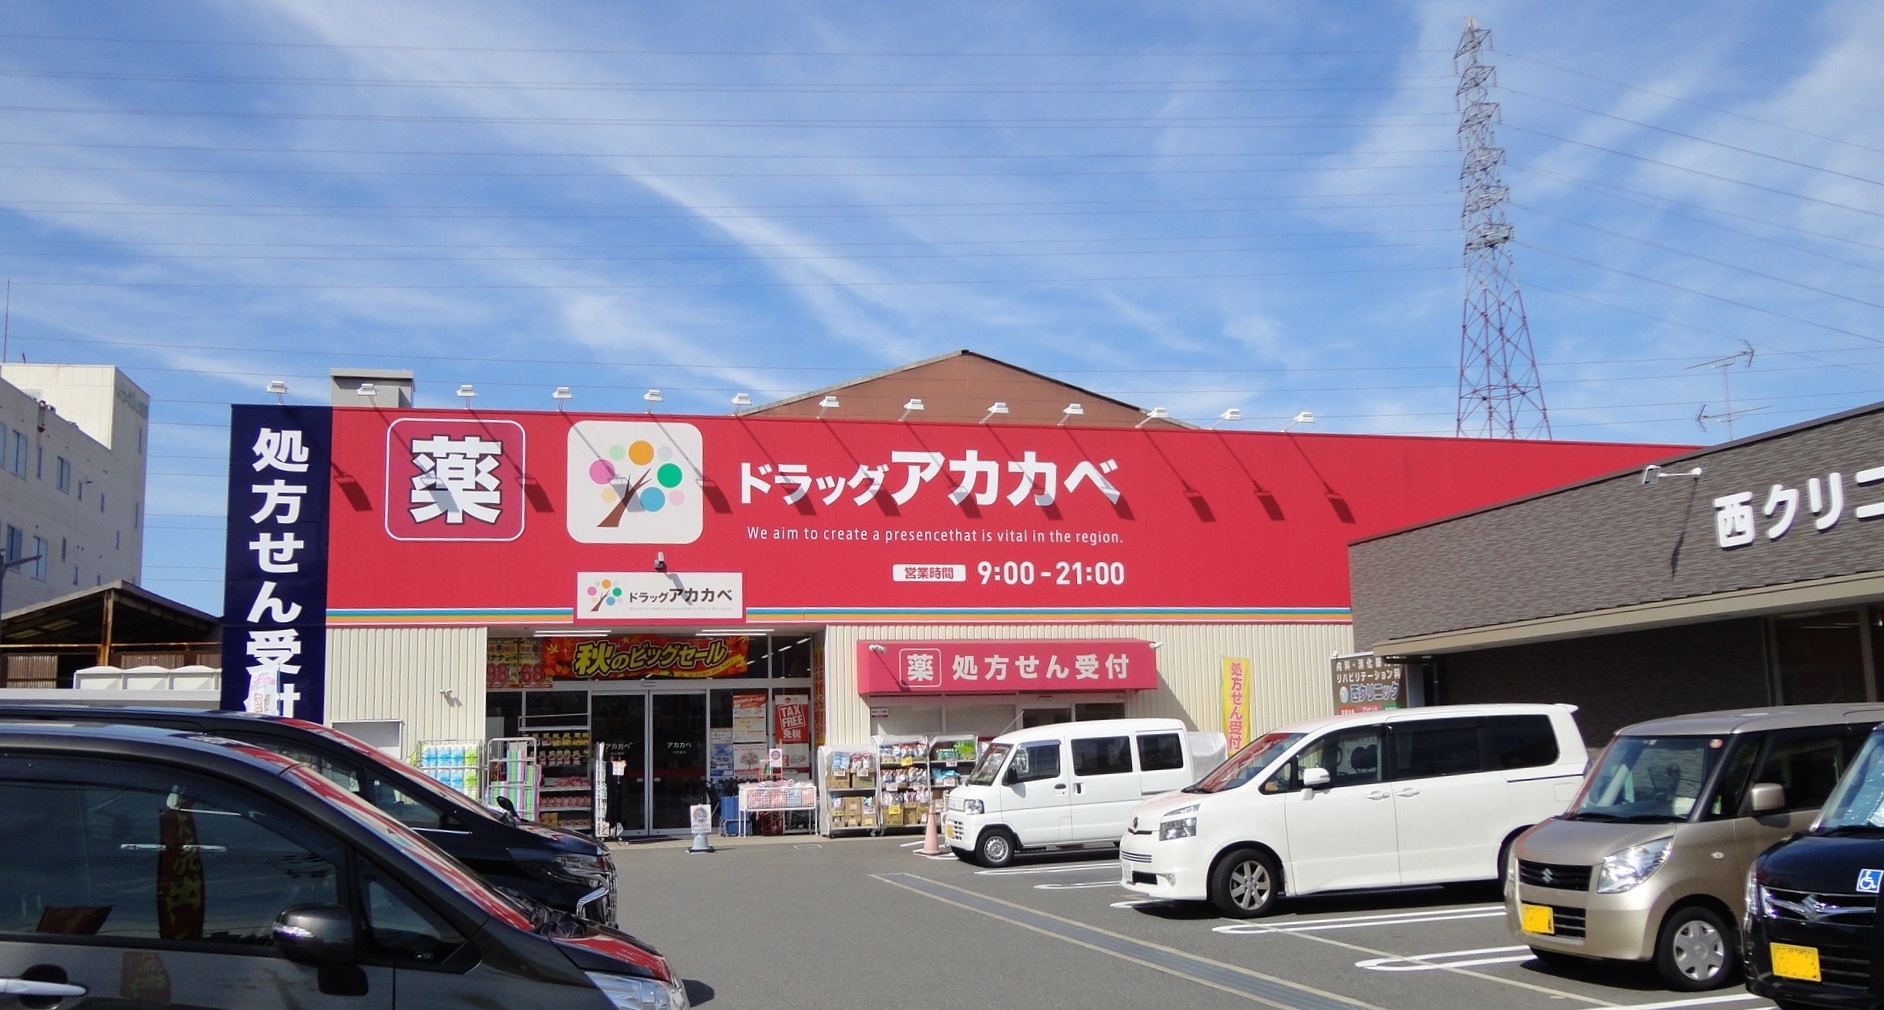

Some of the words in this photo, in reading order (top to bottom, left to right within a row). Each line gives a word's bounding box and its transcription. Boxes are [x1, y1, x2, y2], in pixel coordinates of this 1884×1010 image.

[409, 434, 503, 525] 薬
[740, 449, 1121, 508] ドラッグアカカベ
[747, 526, 768, 540] We
[772, 526, 799, 540] aim
[803, 527, 818, 540] to
[823, 528, 868, 541] create
[872, 530, 880, 541] a
[885, 528, 977, 544] presencethat
[981, 528, 993, 542] is
[996, 529, 1028, 543] vital
[1032, 529, 1045, 543] in
[1048, 529, 1072, 543] the
[1075, 530, 1124, 545] region.
[904, 567, 954, 580] 営業時間
[629, 588, 733, 603] ドラッグアカカベ
[574, 640, 727, 677] 秋のビッグセール
[906, 654, 934, 682] 薬
[951, 653, 1130, 681] 処方せん受付
[1336, 668, 1401, 684] リハビリテーション科
[1349, 681, 1400, 703] 西クリニック
[780, 704, 801, 717] TAX
[1229, 661, 1243, 750] 処方せん受付
[782, 716, 804, 728] FREE
